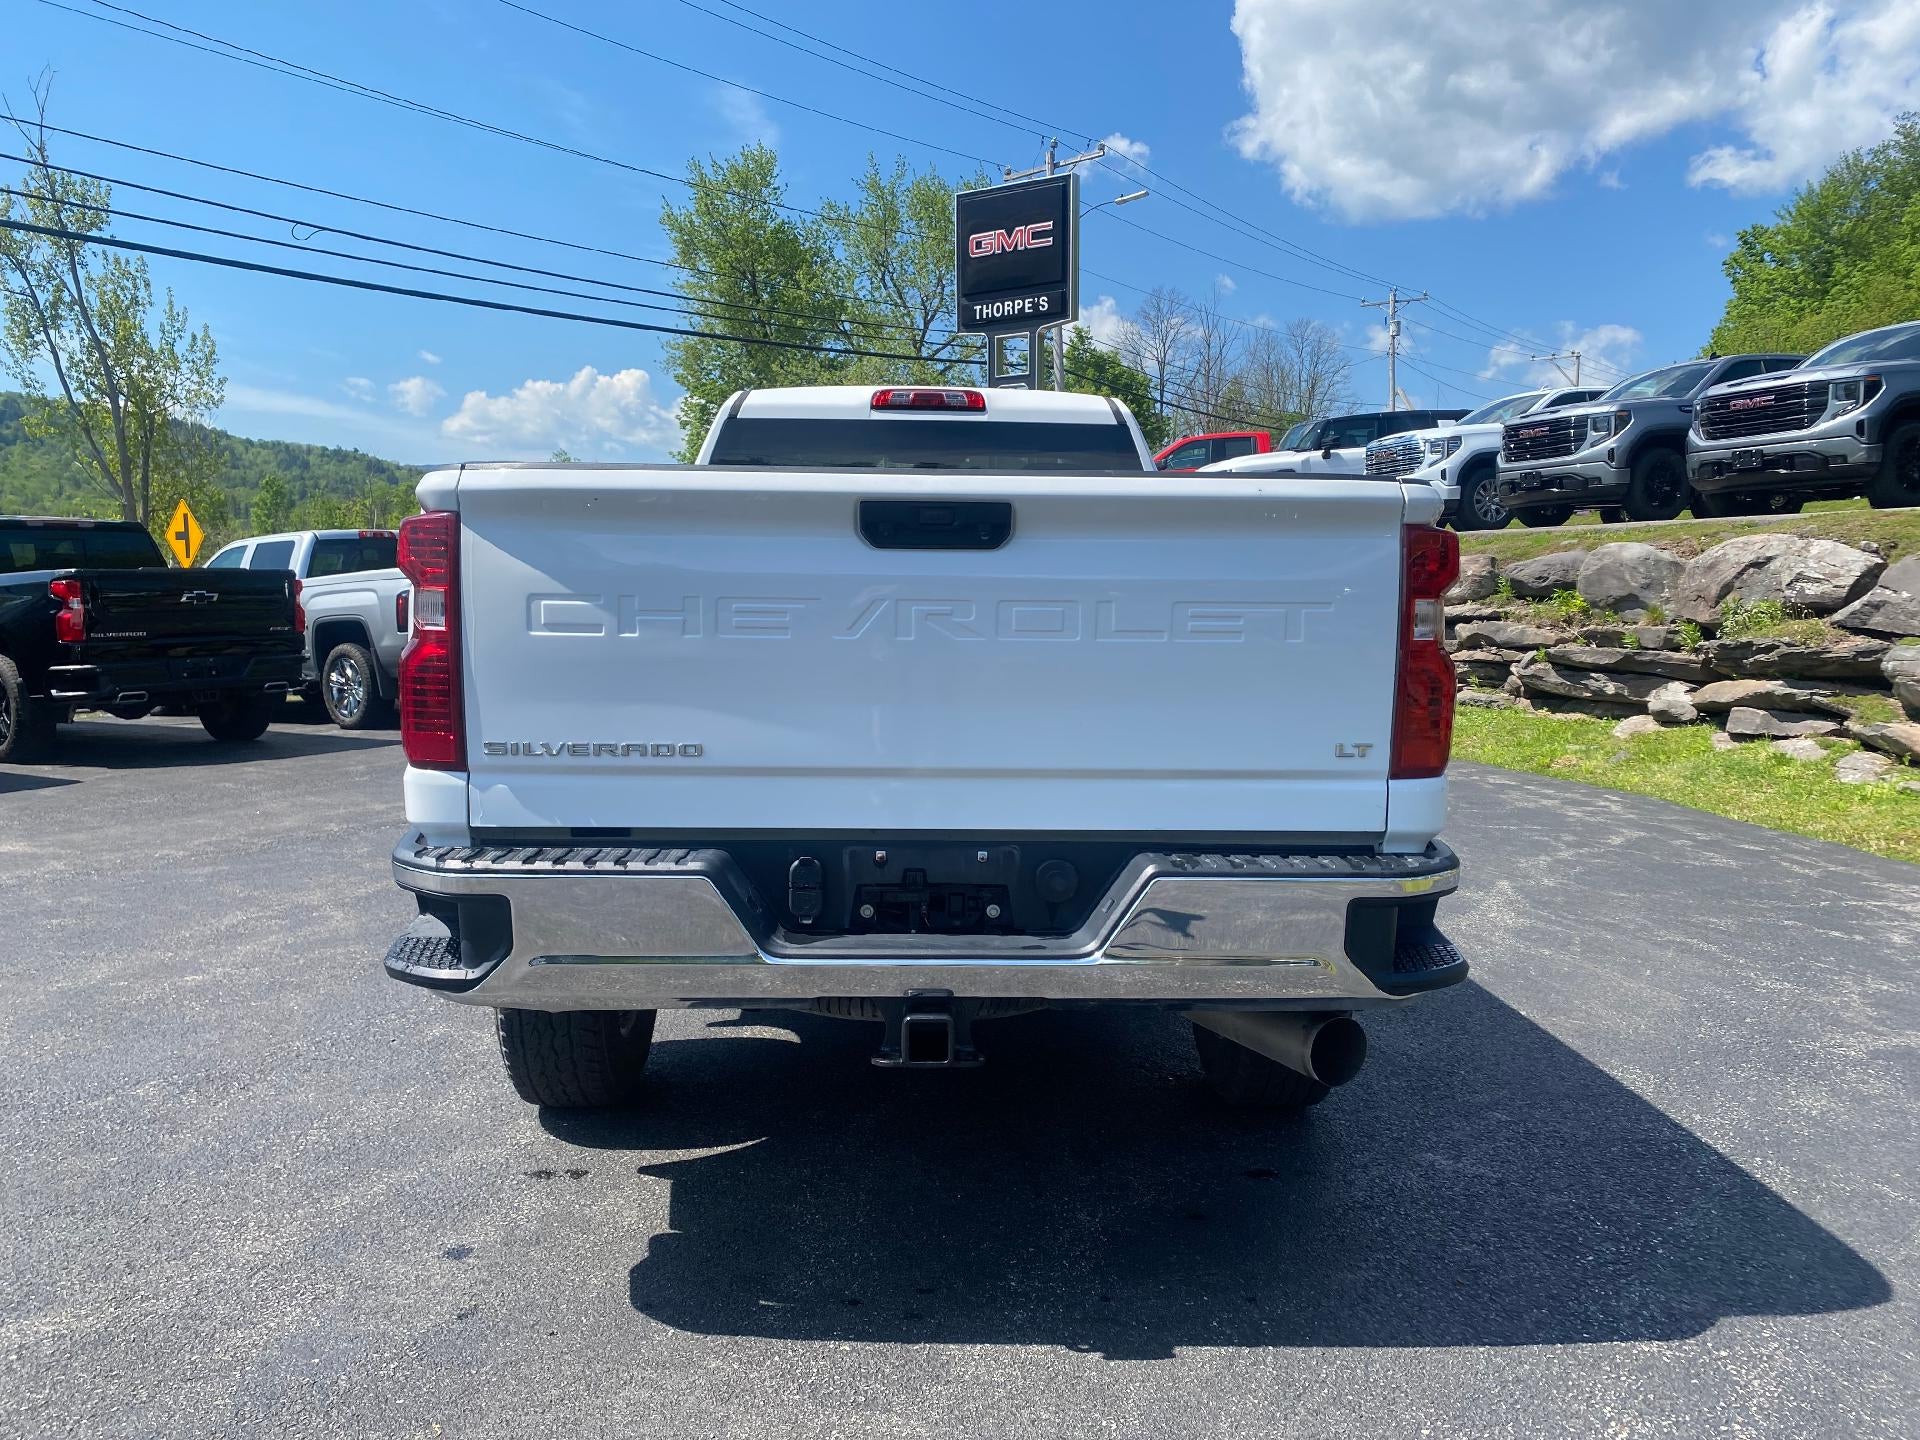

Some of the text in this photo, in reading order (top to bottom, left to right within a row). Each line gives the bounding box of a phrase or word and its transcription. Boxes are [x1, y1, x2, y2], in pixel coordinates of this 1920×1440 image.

[968, 220, 1054, 258] GMC
[973, 296, 1049, 320] THORPE'S
[1729, 395, 1775, 410] GMC
[525, 593, 1335, 643] CHEVROLET
[483, 741, 703, 757] SILVERADO
[1334, 743, 1373, 757] LT
